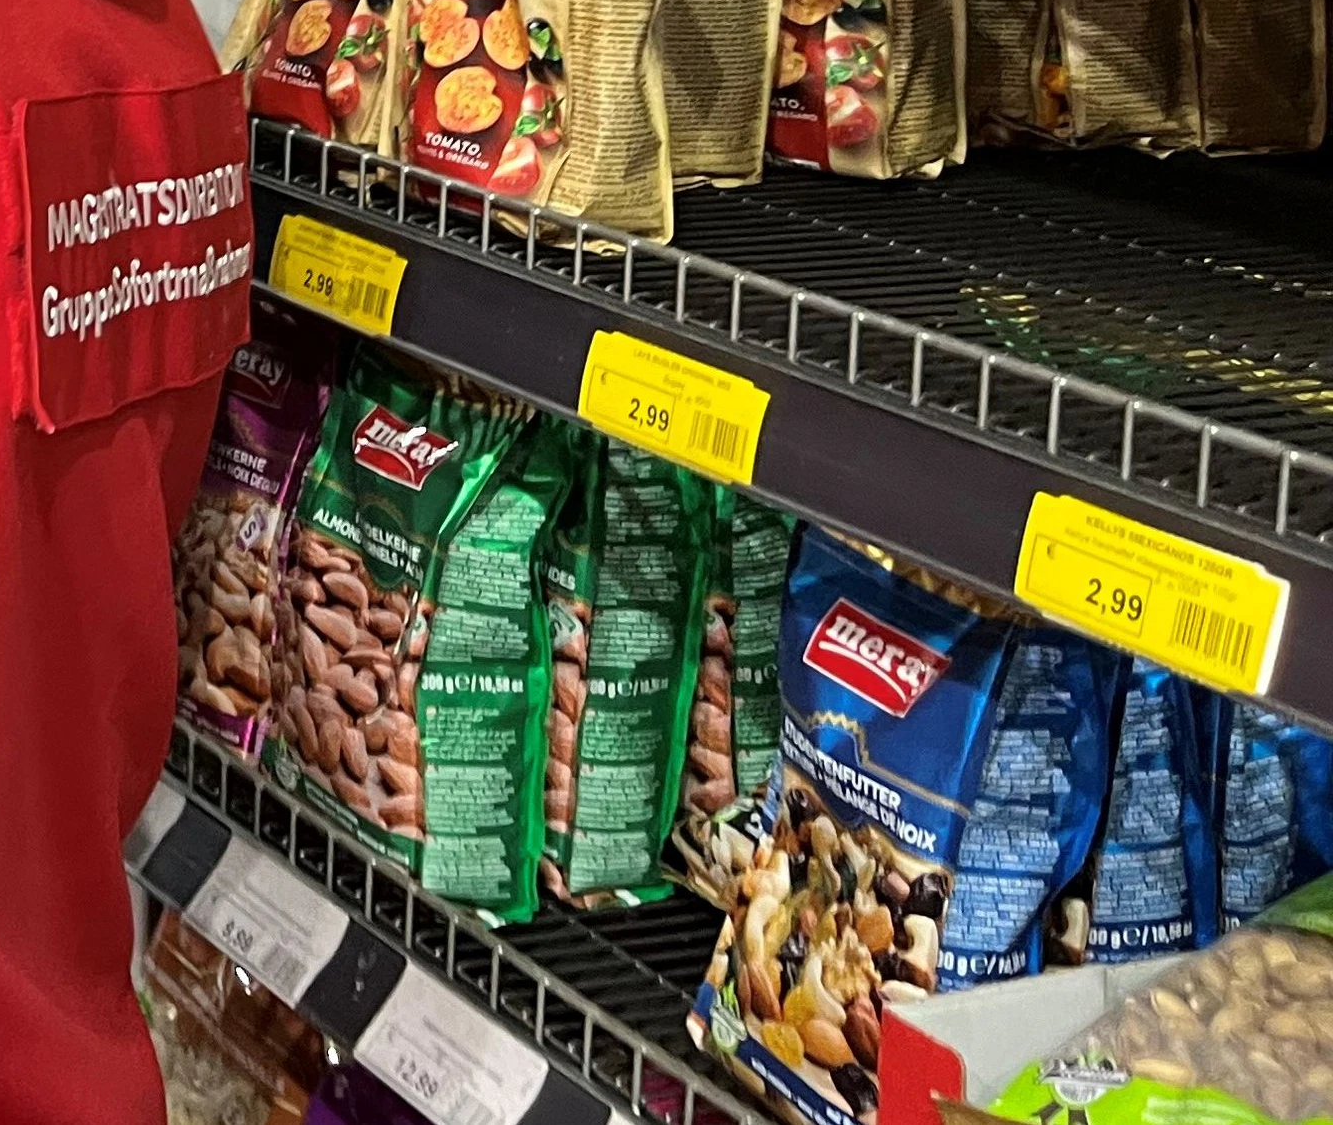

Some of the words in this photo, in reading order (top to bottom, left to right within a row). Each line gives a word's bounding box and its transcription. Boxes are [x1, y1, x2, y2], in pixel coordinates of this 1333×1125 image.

[424, 133, 483, 158] TOMATO,
[234, 349, 285, 386] eray
[628, 397, 670, 432] 2,99
[1085, 577, 1143, 622] 2,99
